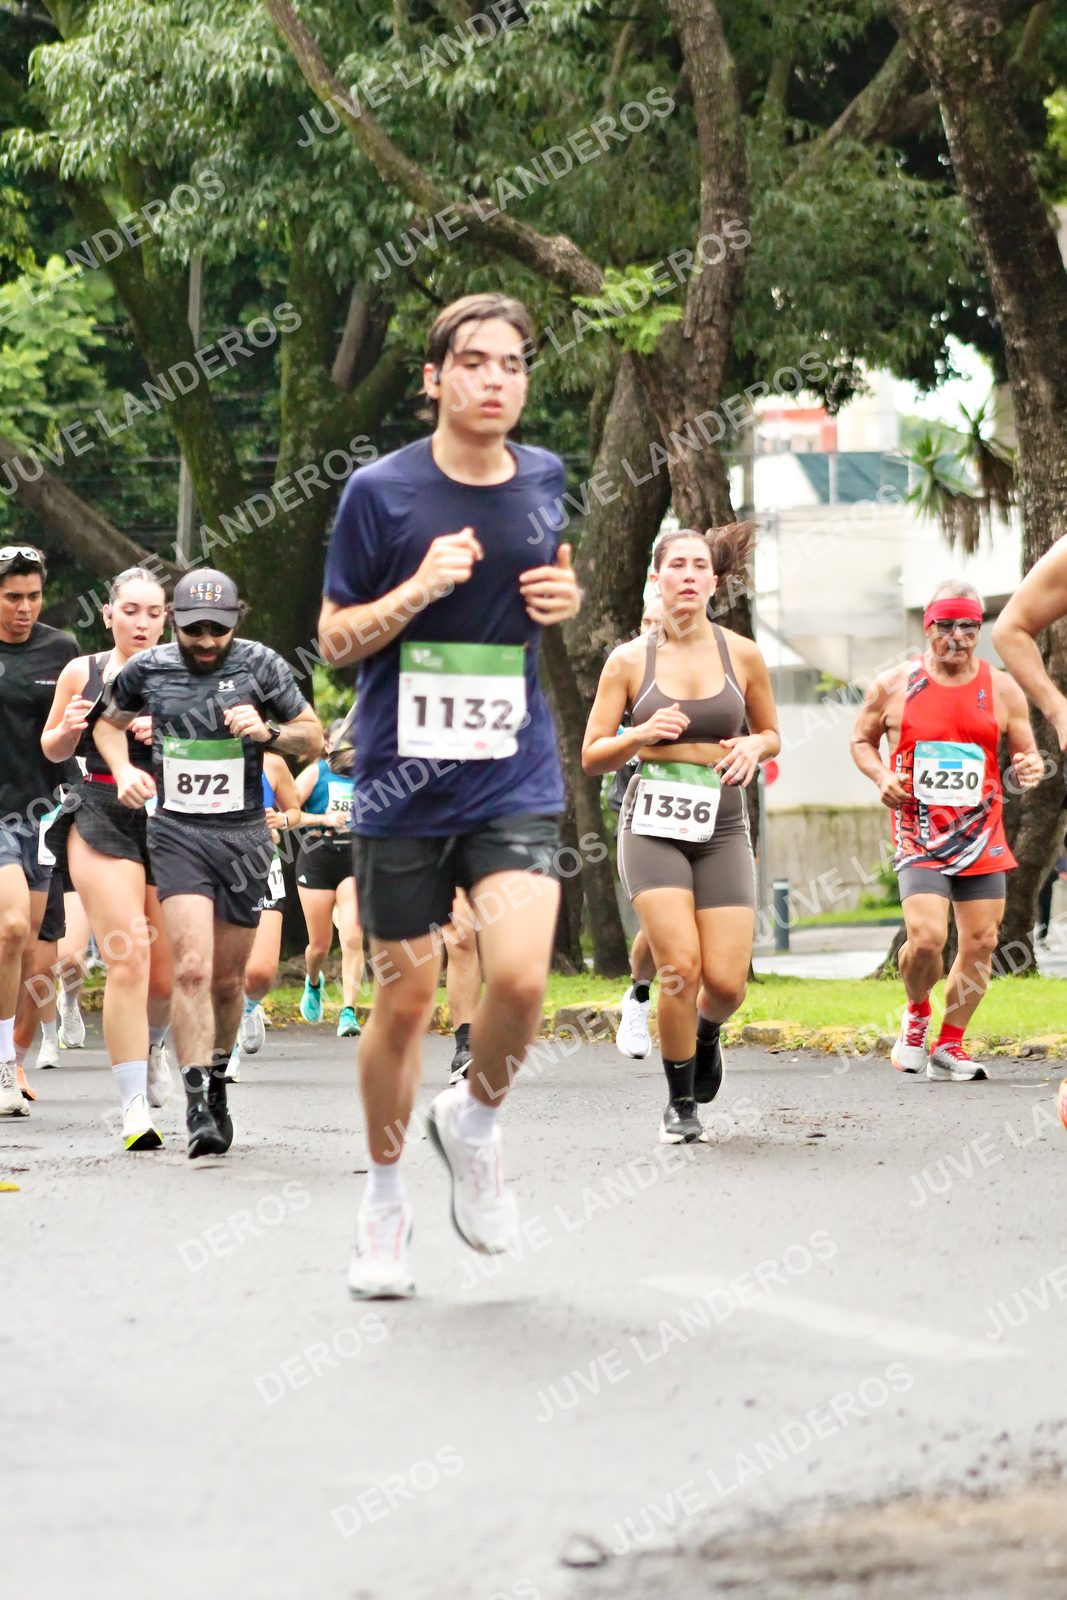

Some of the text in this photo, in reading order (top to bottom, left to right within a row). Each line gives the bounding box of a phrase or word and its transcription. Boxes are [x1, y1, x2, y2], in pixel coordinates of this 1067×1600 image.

[413, 696, 513, 730] 1132
[177, 773, 230, 795] 872
[919, 770, 979, 790] 4230
[643, 794, 711, 824] 1336
[918, 800, 931, 839] RUT
